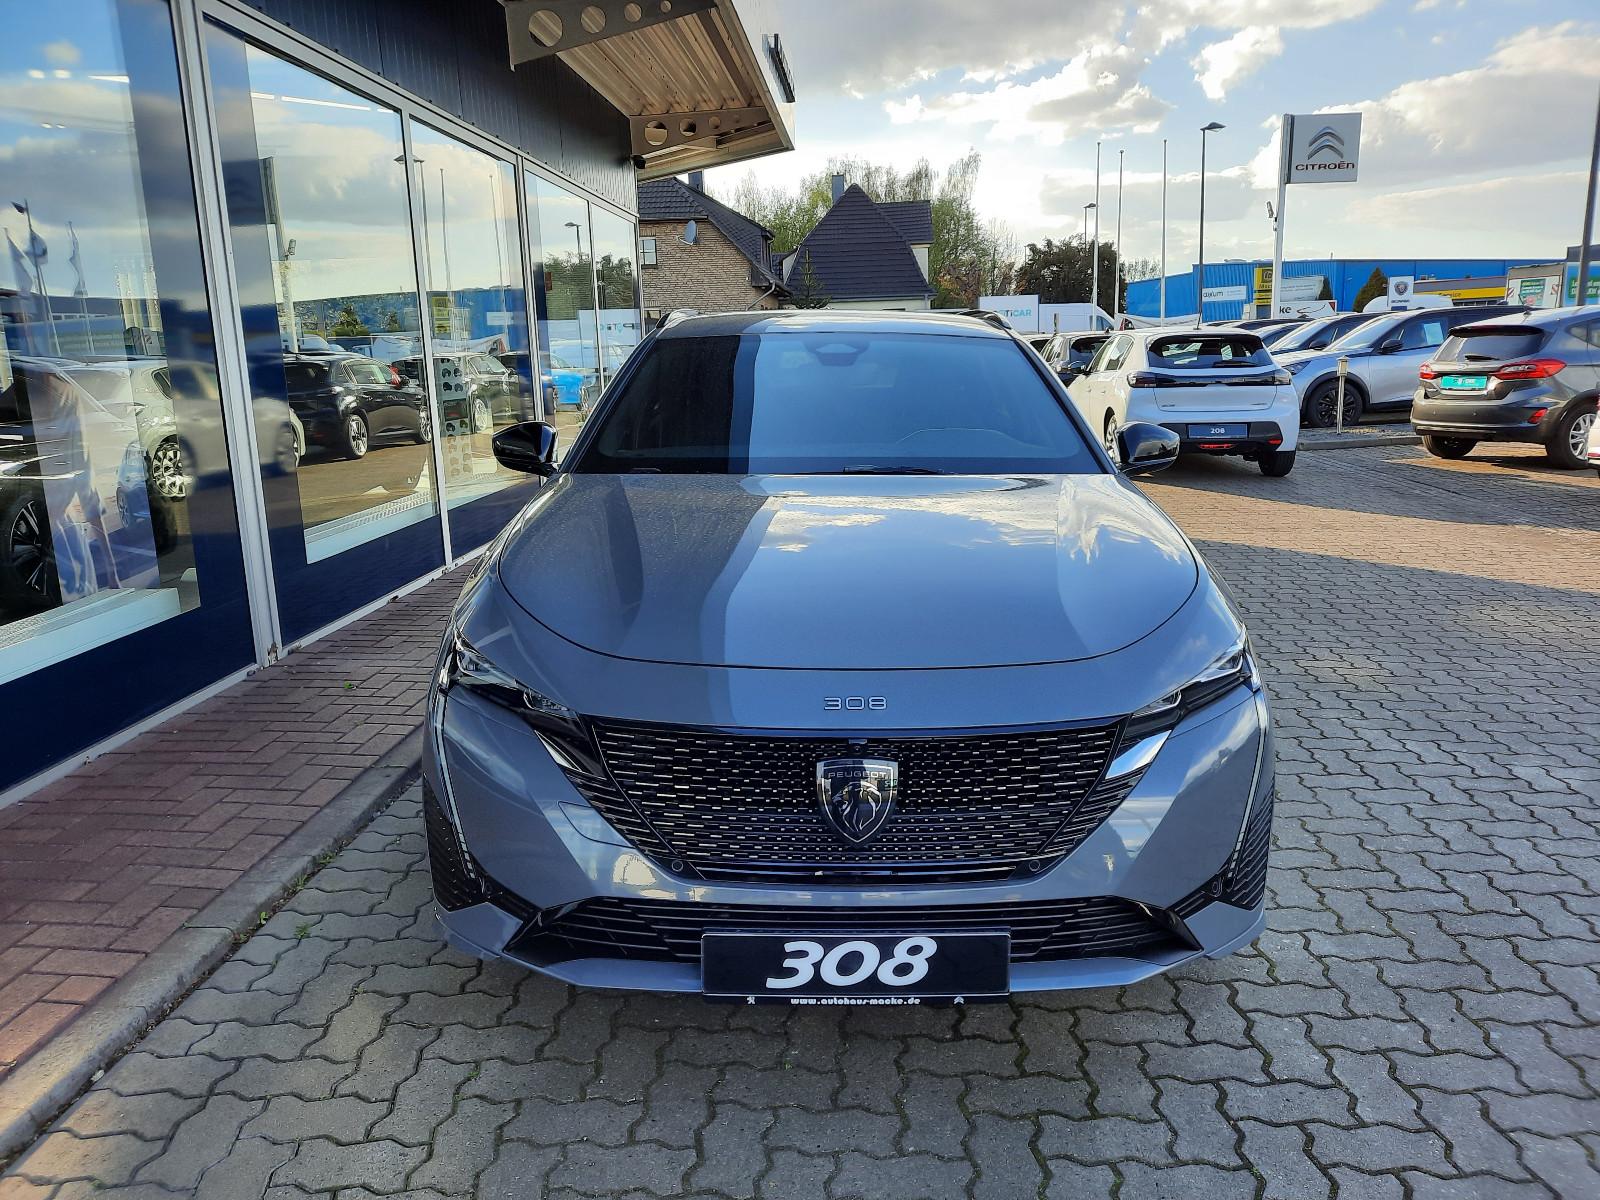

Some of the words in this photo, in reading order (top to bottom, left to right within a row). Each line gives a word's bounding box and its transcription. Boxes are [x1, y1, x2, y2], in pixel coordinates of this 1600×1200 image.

[1280, 305, 1292, 314] ke
[824, 696, 887, 710] 308
[765, 936, 938, 989] 308
